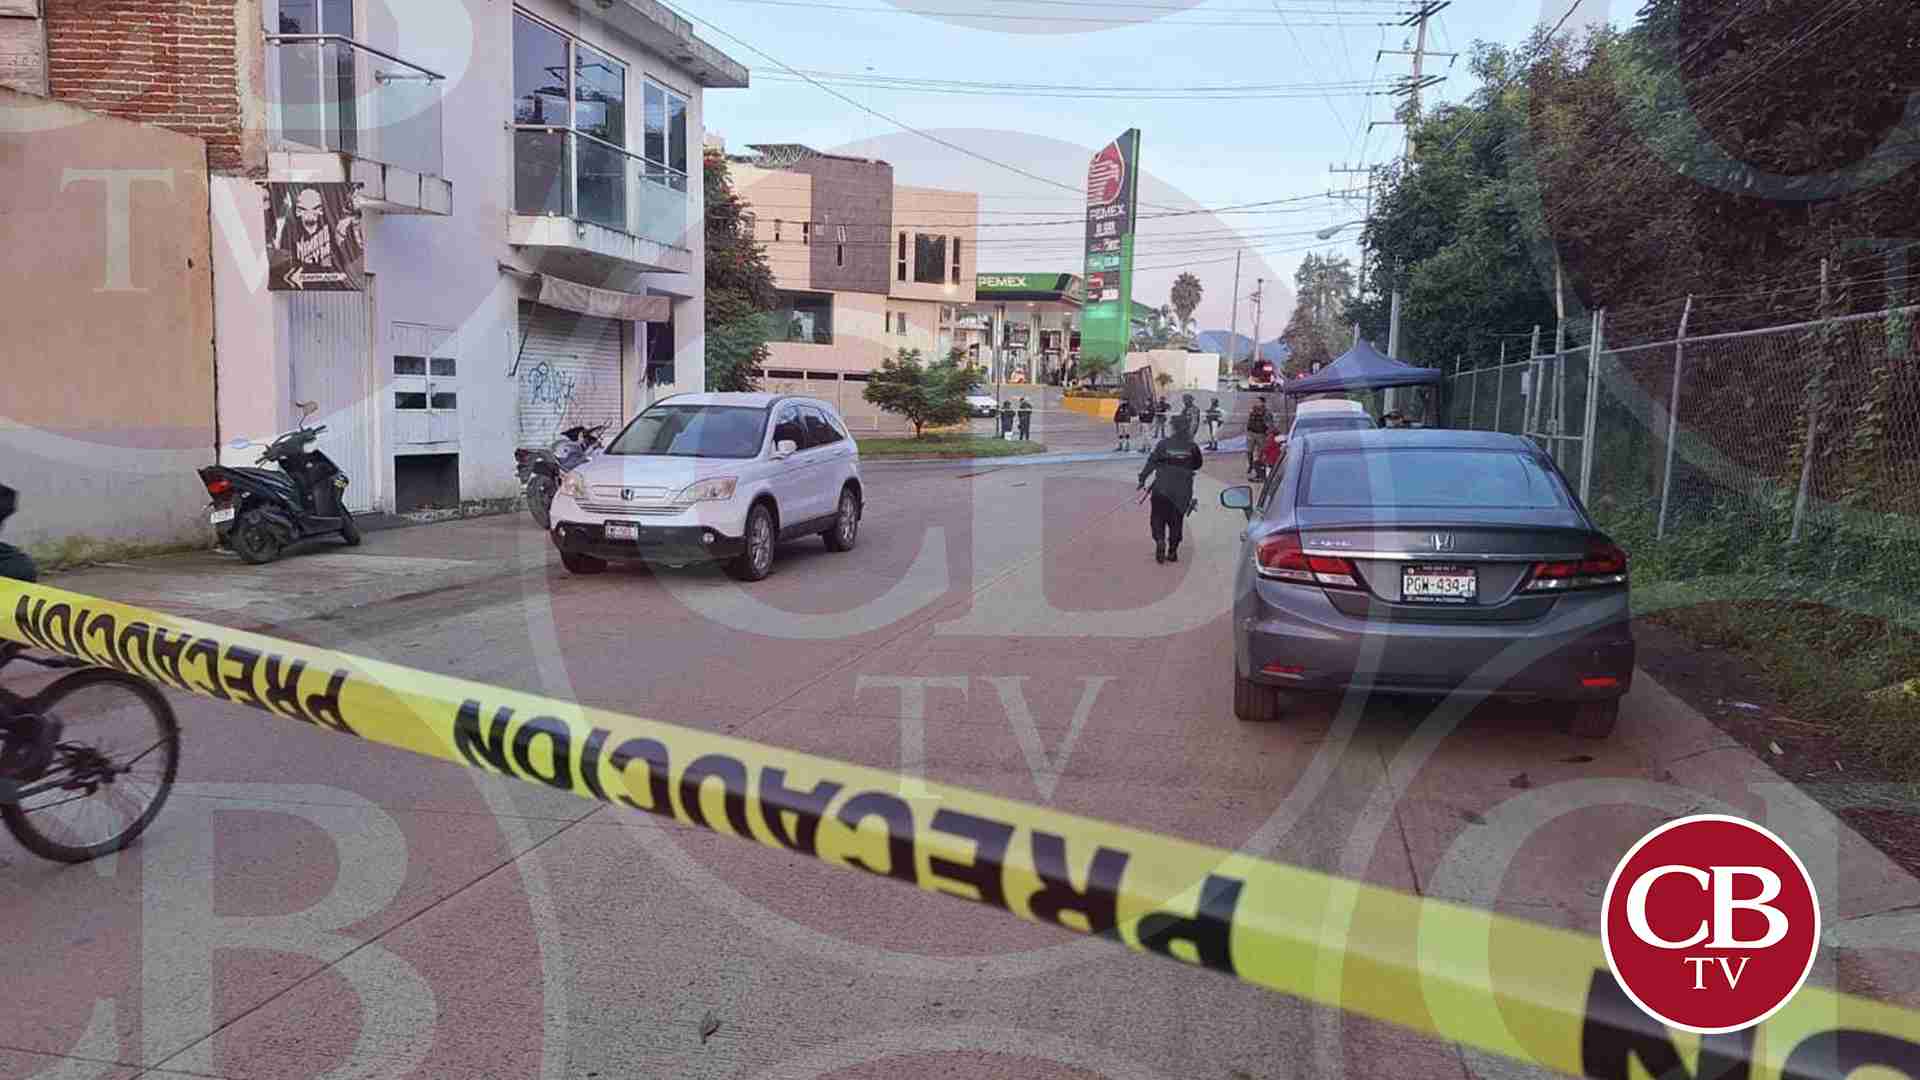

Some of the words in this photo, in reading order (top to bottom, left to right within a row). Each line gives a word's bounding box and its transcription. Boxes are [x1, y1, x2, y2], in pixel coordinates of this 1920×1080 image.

[1089, 204, 1126, 220] PEMEX
[978, 275, 1026, 287] PEMEX
[454, 698, 1246, 977] PRECAUCION
